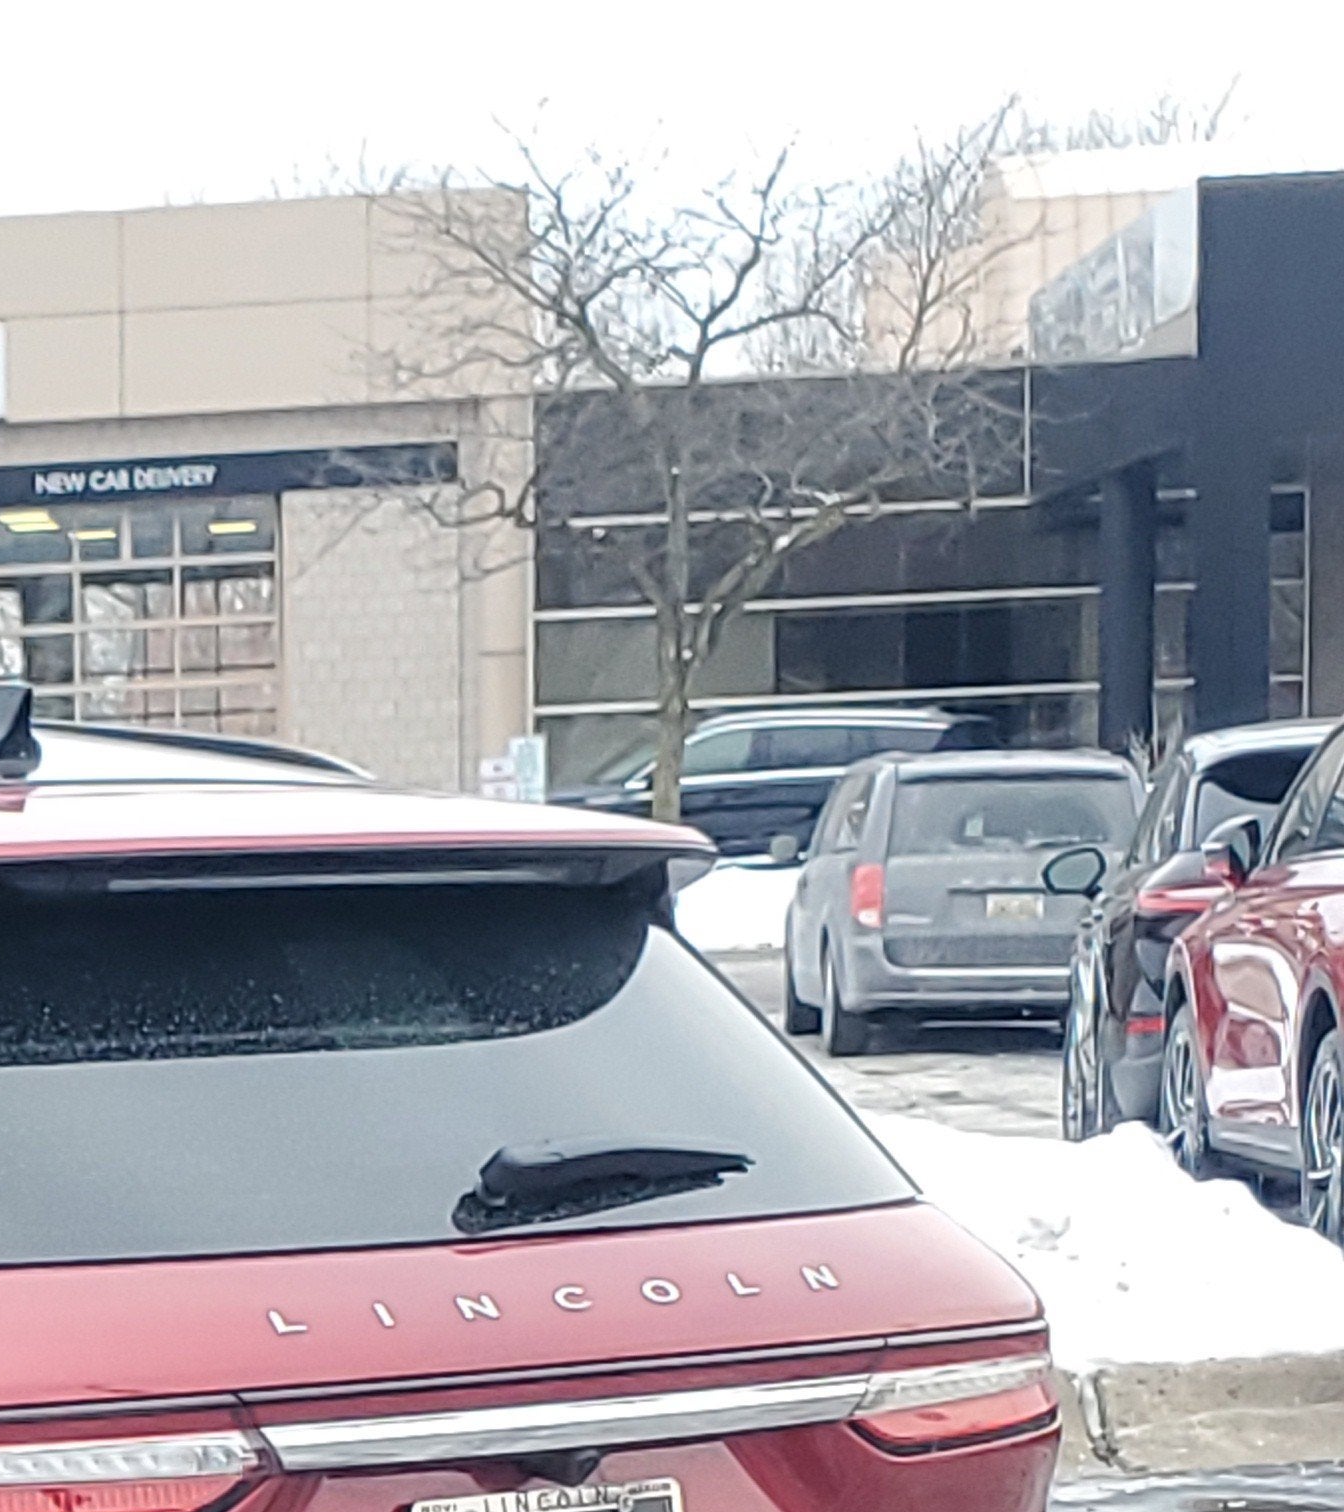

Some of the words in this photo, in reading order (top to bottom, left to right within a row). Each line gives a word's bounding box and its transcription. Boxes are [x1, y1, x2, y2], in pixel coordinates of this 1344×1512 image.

[34, 471, 86, 495] NEW
[89, 469, 130, 492] CAR
[133, 464, 218, 490] DELIVERY
[267, 1264, 842, 1335] LINCOLN
